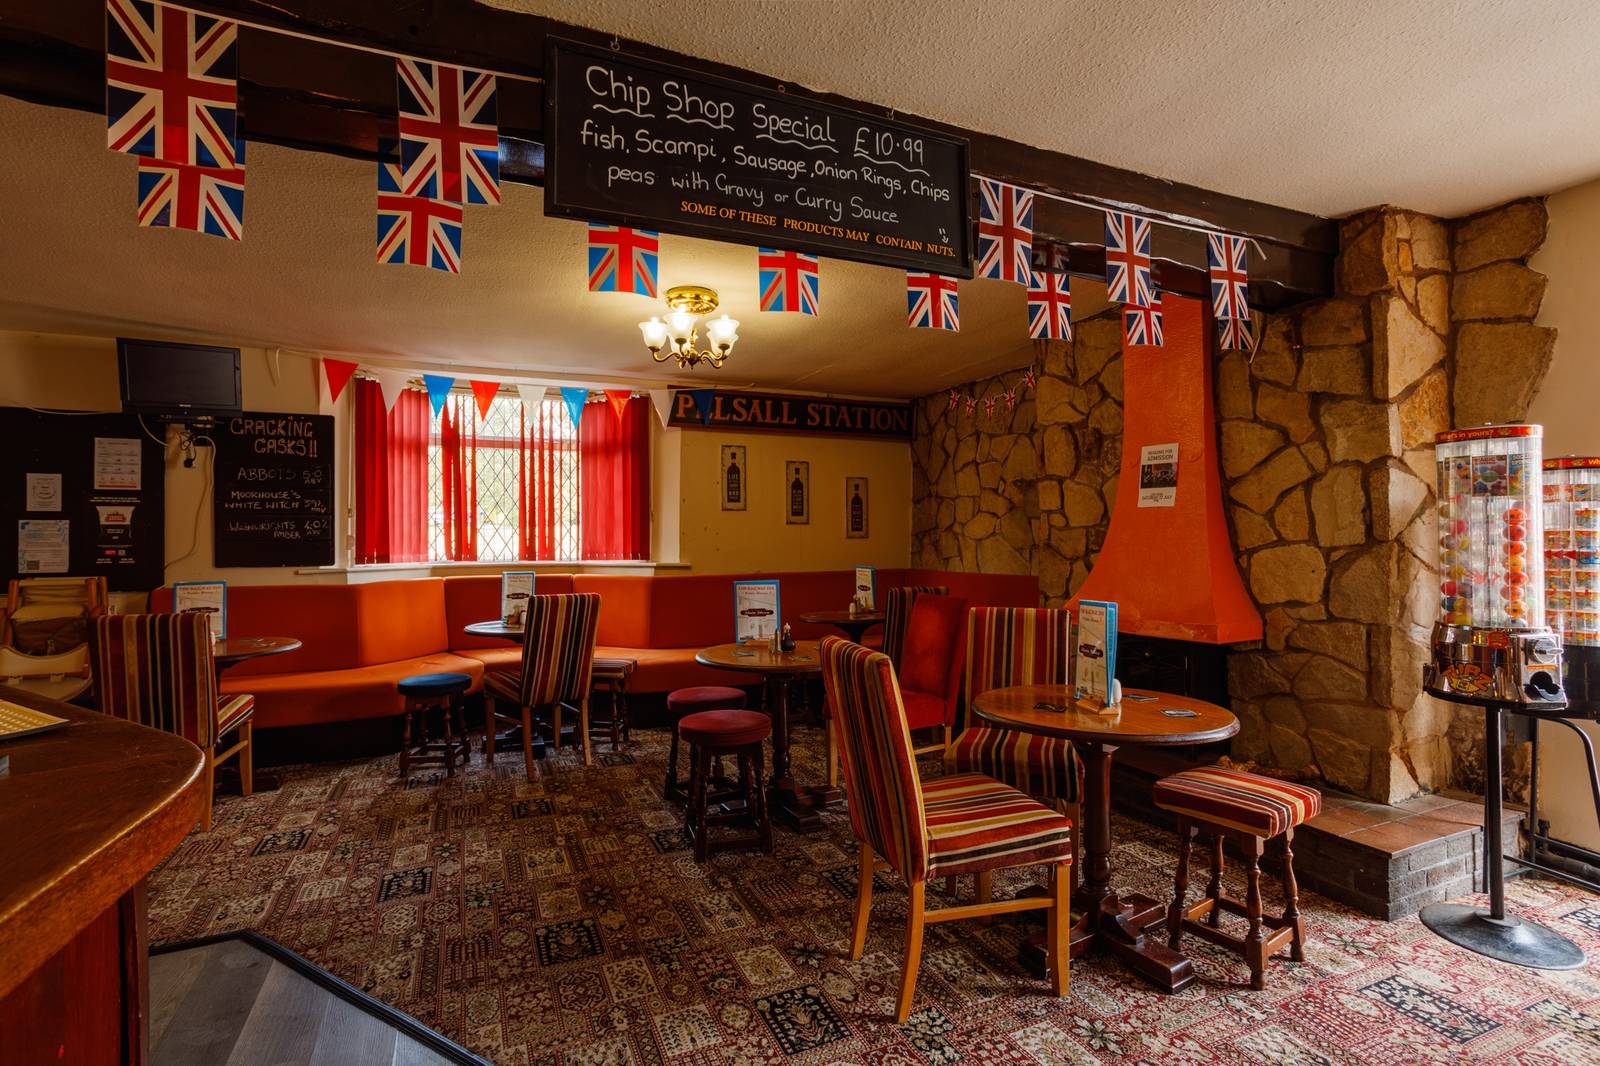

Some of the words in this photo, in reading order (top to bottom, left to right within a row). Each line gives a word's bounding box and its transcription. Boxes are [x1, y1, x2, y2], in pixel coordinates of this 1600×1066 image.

[586, 66, 650, 114] Chip
[663, 81, 735, 128] Shop
[753, 103, 836, 142] Special
[608, 166, 655, 188] peas
[671, 170, 709, 191] with
[715, 173, 764, 207] Gravy
[774, 193, 789, 202] or
[795, 187, 842, 222] Curry
[850, 196, 899, 223] Sauce
[861, 167, 907, 199] Rings,
[911, 180, 950, 202] Chips
[681, 201, 717, 216] SOME
[719, 207, 737, 219] OF
[739, 210, 777, 226] THESE
[783, 217, 844, 238] PRODUCTS
[846, 229, 870, 242] MAY
[876, 234, 923, 251] CONTAIN
[927, 243, 956, 257] NUTS.
[675, 393, 797, 425] PLSALL
[807, 403, 909, 431] STATION
